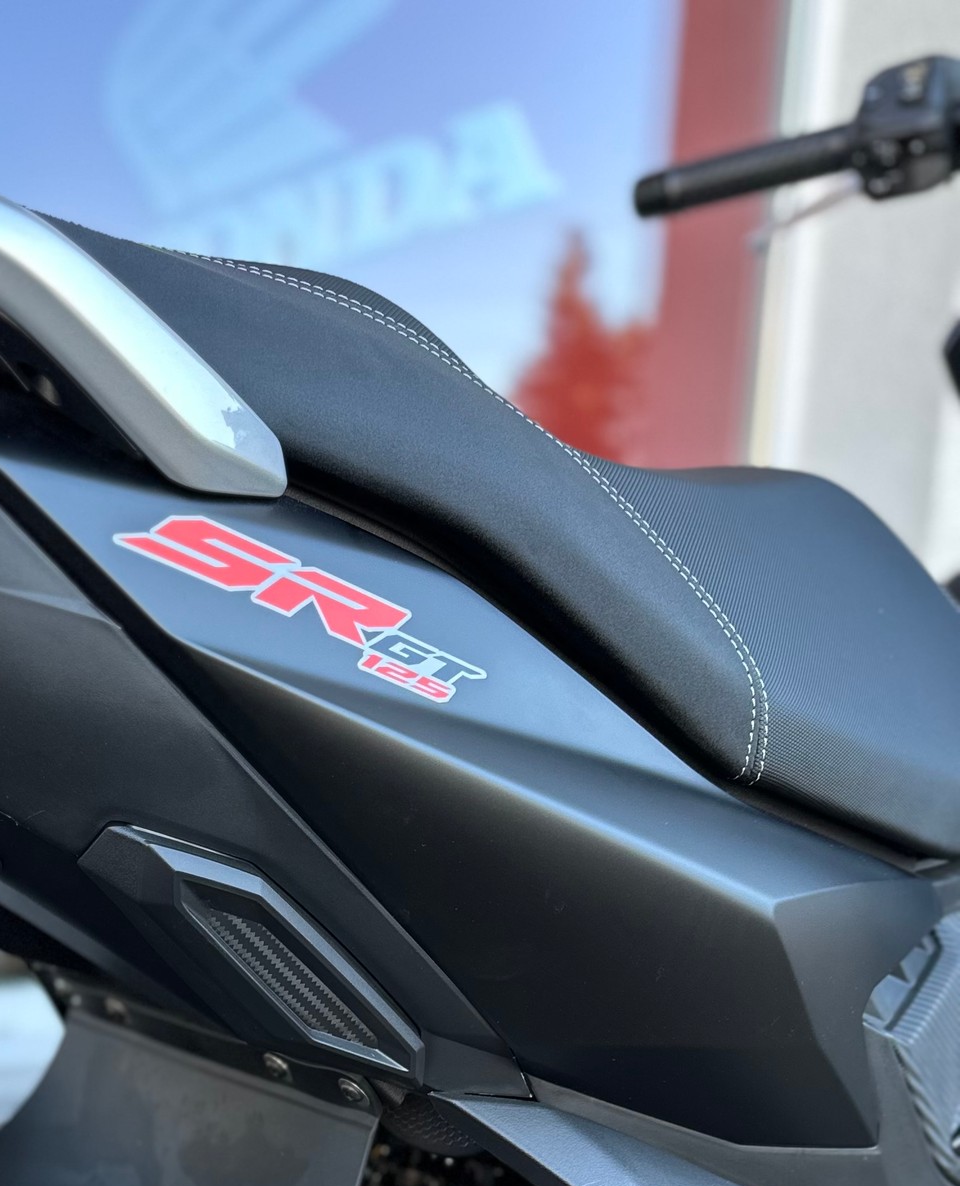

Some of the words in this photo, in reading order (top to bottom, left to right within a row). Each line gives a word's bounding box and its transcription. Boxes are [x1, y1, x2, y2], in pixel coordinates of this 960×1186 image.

[113, 515, 412, 650] SR
[363, 629, 487, 686] GT
[357, 650, 456, 703] 125
